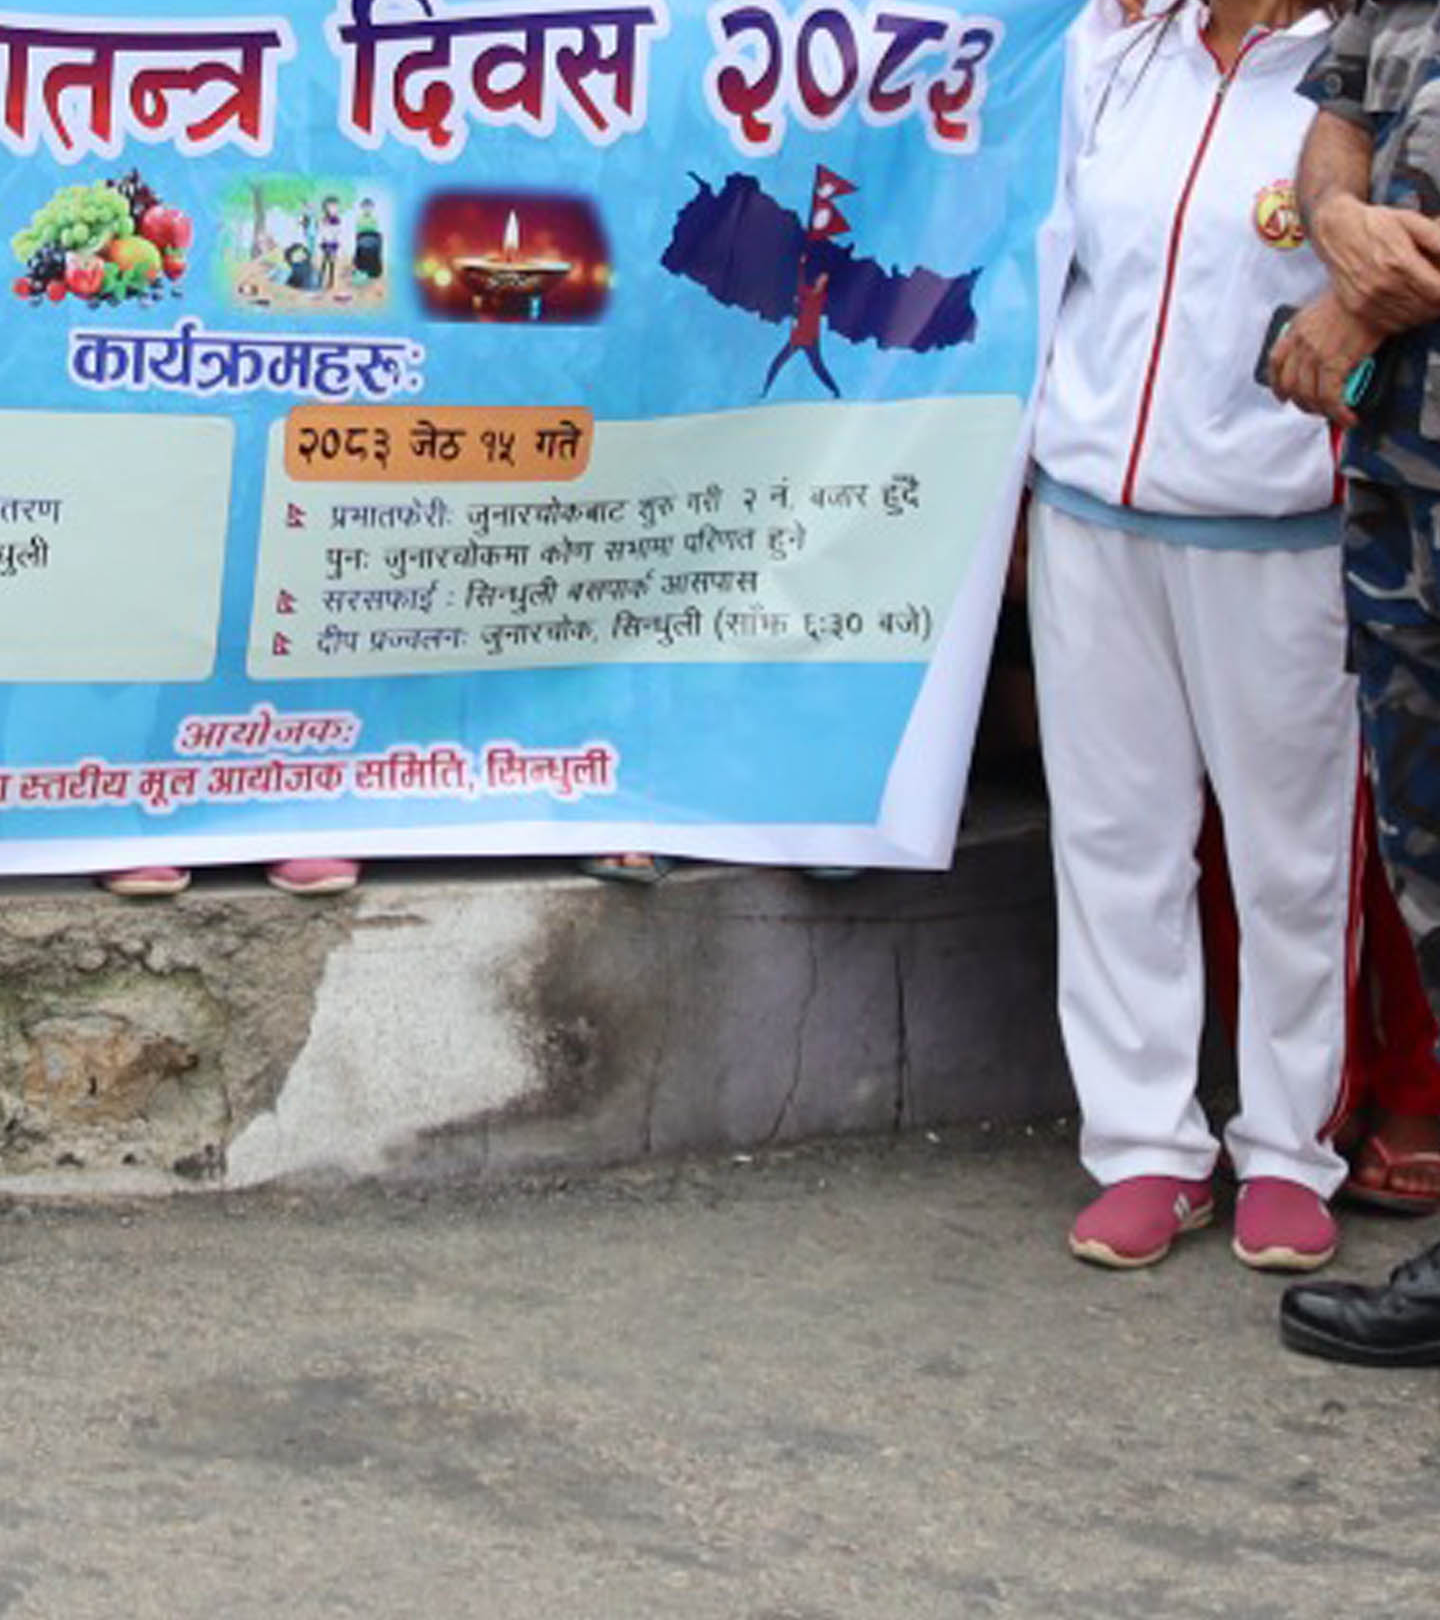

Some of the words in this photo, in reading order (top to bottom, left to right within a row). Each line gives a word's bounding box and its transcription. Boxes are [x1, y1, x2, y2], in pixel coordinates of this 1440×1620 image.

[718, 6, 998, 140] २०८३
[297, 428, 392, 470] २०८३
[410, 420, 466, 461] जेठ
[480, 430, 516, 466] १५
[534, 419, 583, 459] गते
[467, 496, 627, 536] जुनारचोकबाट
[687, 483, 723, 516] गरी
[742, 486, 759, 513] २
[384, 536, 530, 580] जुनारचोकमा
[540, 535, 593, 567] कोण
[683, 523, 756, 555] परिणत
[767, 520, 807, 562] हुने
[322, 581, 438, 615] सरसफाई
[465, 576, 558, 615] सिन्धुली
[567, 569, 654, 604] बसपार्क
[660, 569, 760, 597] आसपास
[316, 624, 359, 656] दीप
[611, 604, 703, 647] सिन्धुली
[878, 602, 934, 642] बजे)
[18, 764, 127, 803] स्तरीय
[138, 761, 196, 810] मूल
[206, 756, 342, 797] आयोजक
[485, 749, 611, 795] सिन्धुली
